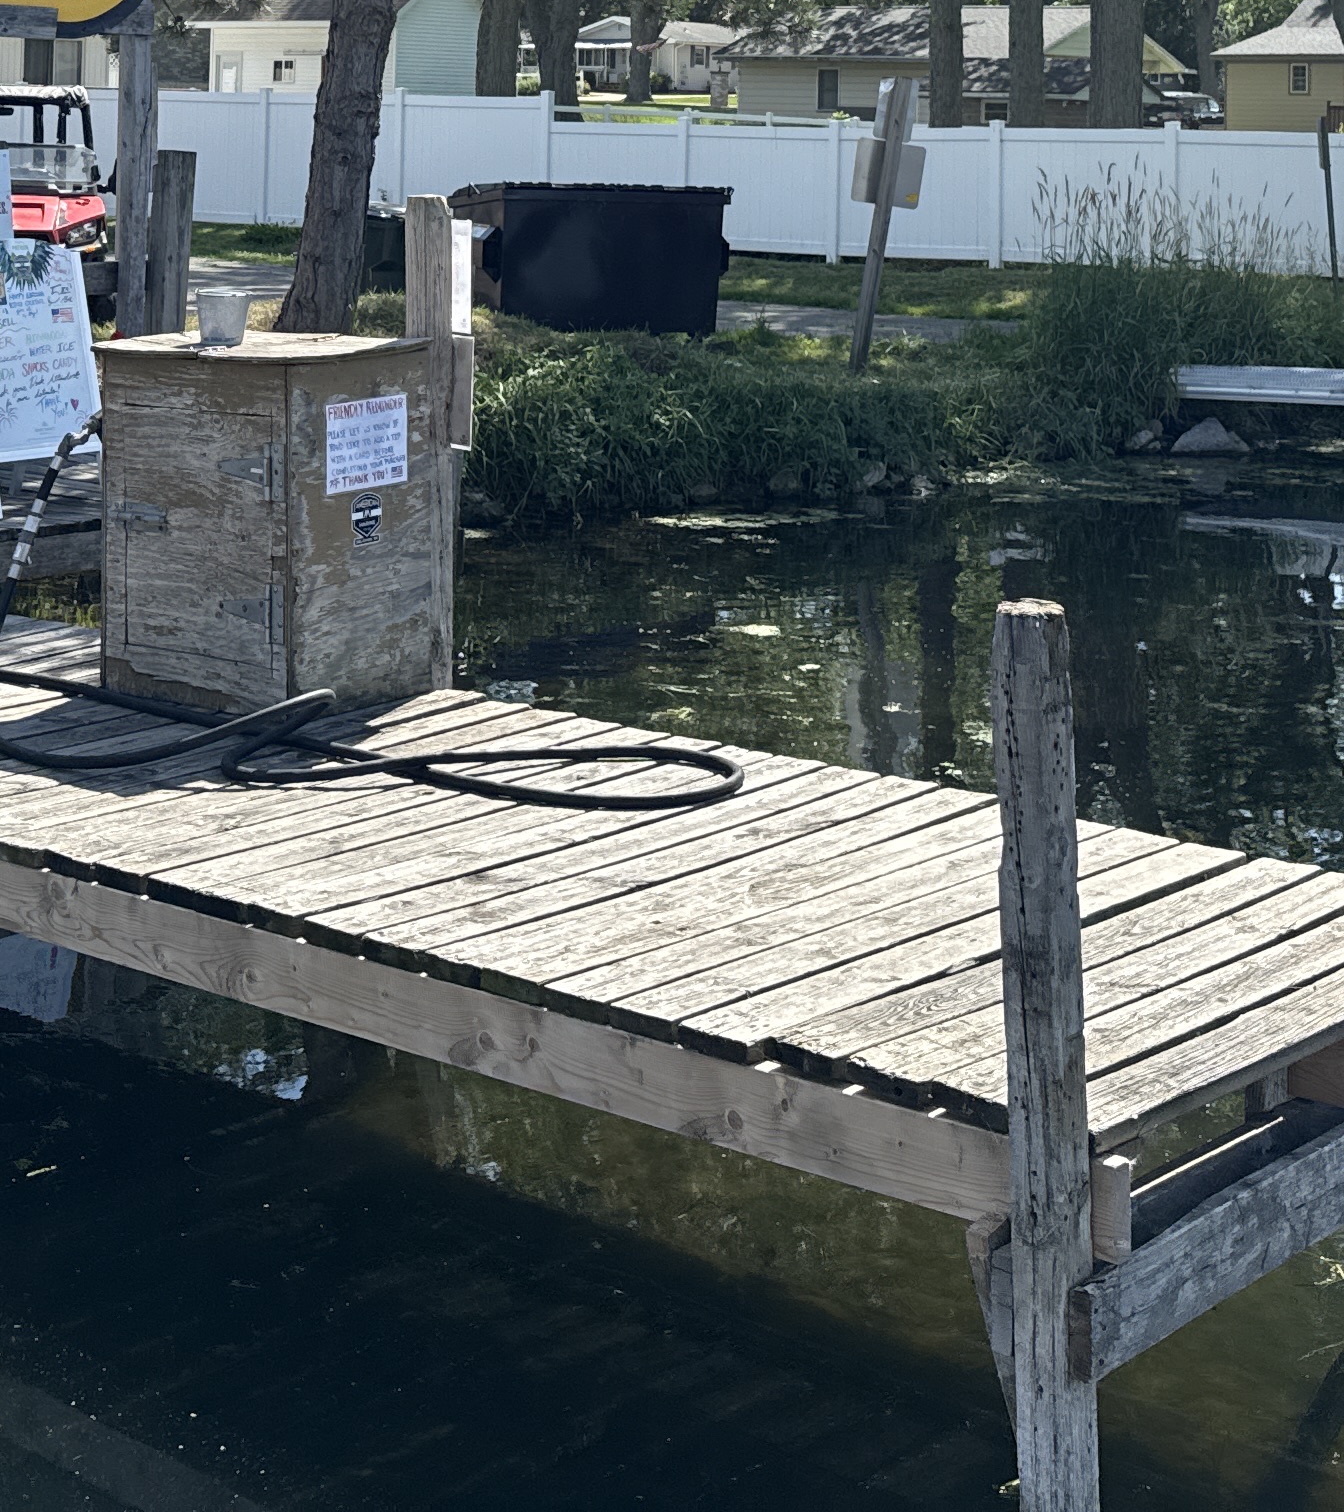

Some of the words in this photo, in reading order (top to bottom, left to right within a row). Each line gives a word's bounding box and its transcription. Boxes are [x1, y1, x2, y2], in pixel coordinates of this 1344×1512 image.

[29, 344, 53, 357] WATER
[56, 341, 76, 353] ICE
[52, 357, 77, 370] CANDY
[328, 401, 364, 422] FRIENDLY
[366, 397, 404, 415] REMINDER
[349, 427, 360, 437] LET
[346, 440, 360, 450] LIKE
[362, 437, 372, 447] TO
[348, 453, 353, 462] A
[342, 472, 369, 488] THANK
